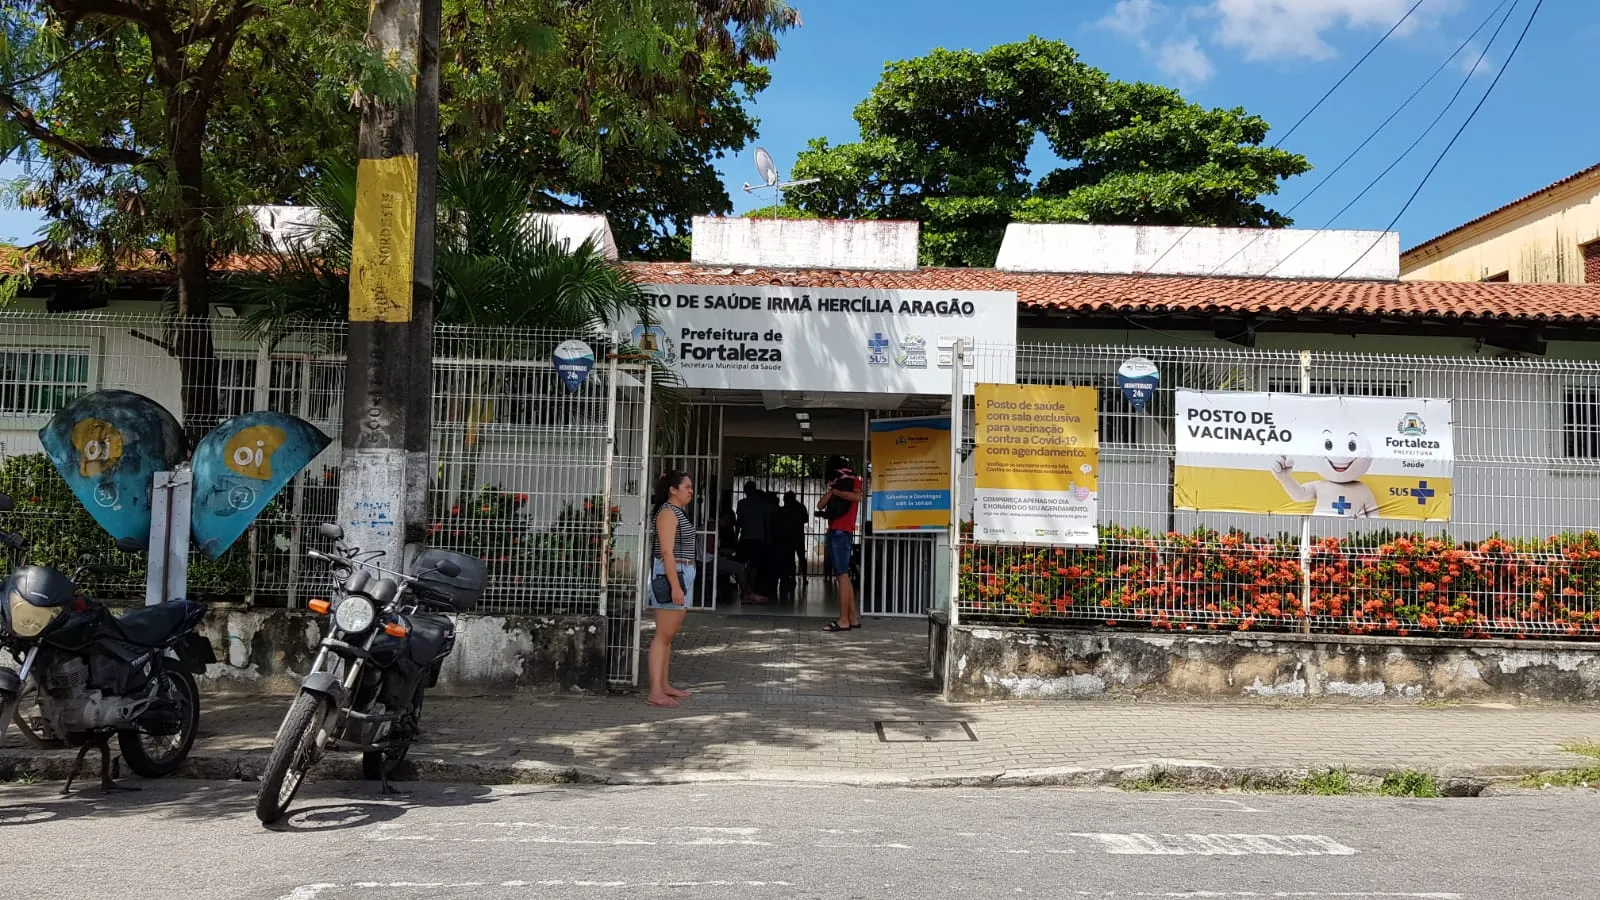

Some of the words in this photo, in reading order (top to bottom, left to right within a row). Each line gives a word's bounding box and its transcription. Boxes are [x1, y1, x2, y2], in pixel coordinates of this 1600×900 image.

[676, 295, 699, 308] DE
[704, 293, 761, 310] SAÚDE
[767, 295, 812, 311] IRMÃ
[818, 296, 893, 313] HERCÍLIA
[900, 299, 975, 315] ARAGÃO
[681, 328, 758, 341] Prefeitura
[763, 329, 783, 342] de
[680, 343, 782, 362] Fortaleza
[869, 355, 887, 363] SUS
[715, 362, 749, 370] Municipal
[760, 362, 781, 371] Saúde
[1132, 389, 1144, 398] 24h
[987, 400, 1017, 409] Posto
[1019, 400, 1032, 410] de
[1034, 401, 1065, 411] saúde
[987, 413, 1010, 421] com
[1012, 412, 1032, 422] sala
[1034, 413, 1080, 423] exclusiva
[1187, 408, 1247, 424] POSTO
[1251, 411, 1274, 425] DE
[987, 425, 1010, 434] para
[1013, 424, 1064, 436] vacinação
[1187, 425, 1292, 445] VACINAÇÃO
[987, 435, 1020, 444] contra
[1022, 437, 1029, 445] a
[1031, 435, 1077, 446] Covid-19
[1386, 437, 1440, 449] Fortaleza
[987, 447, 1010, 455] com
[1012, 447, 1087, 458] agendamento.
[1402, 460, 1425, 468] Saúde
[1389, 487, 1409, 496] SUS
[983, 496, 1023, 505] COMPAREÇA
